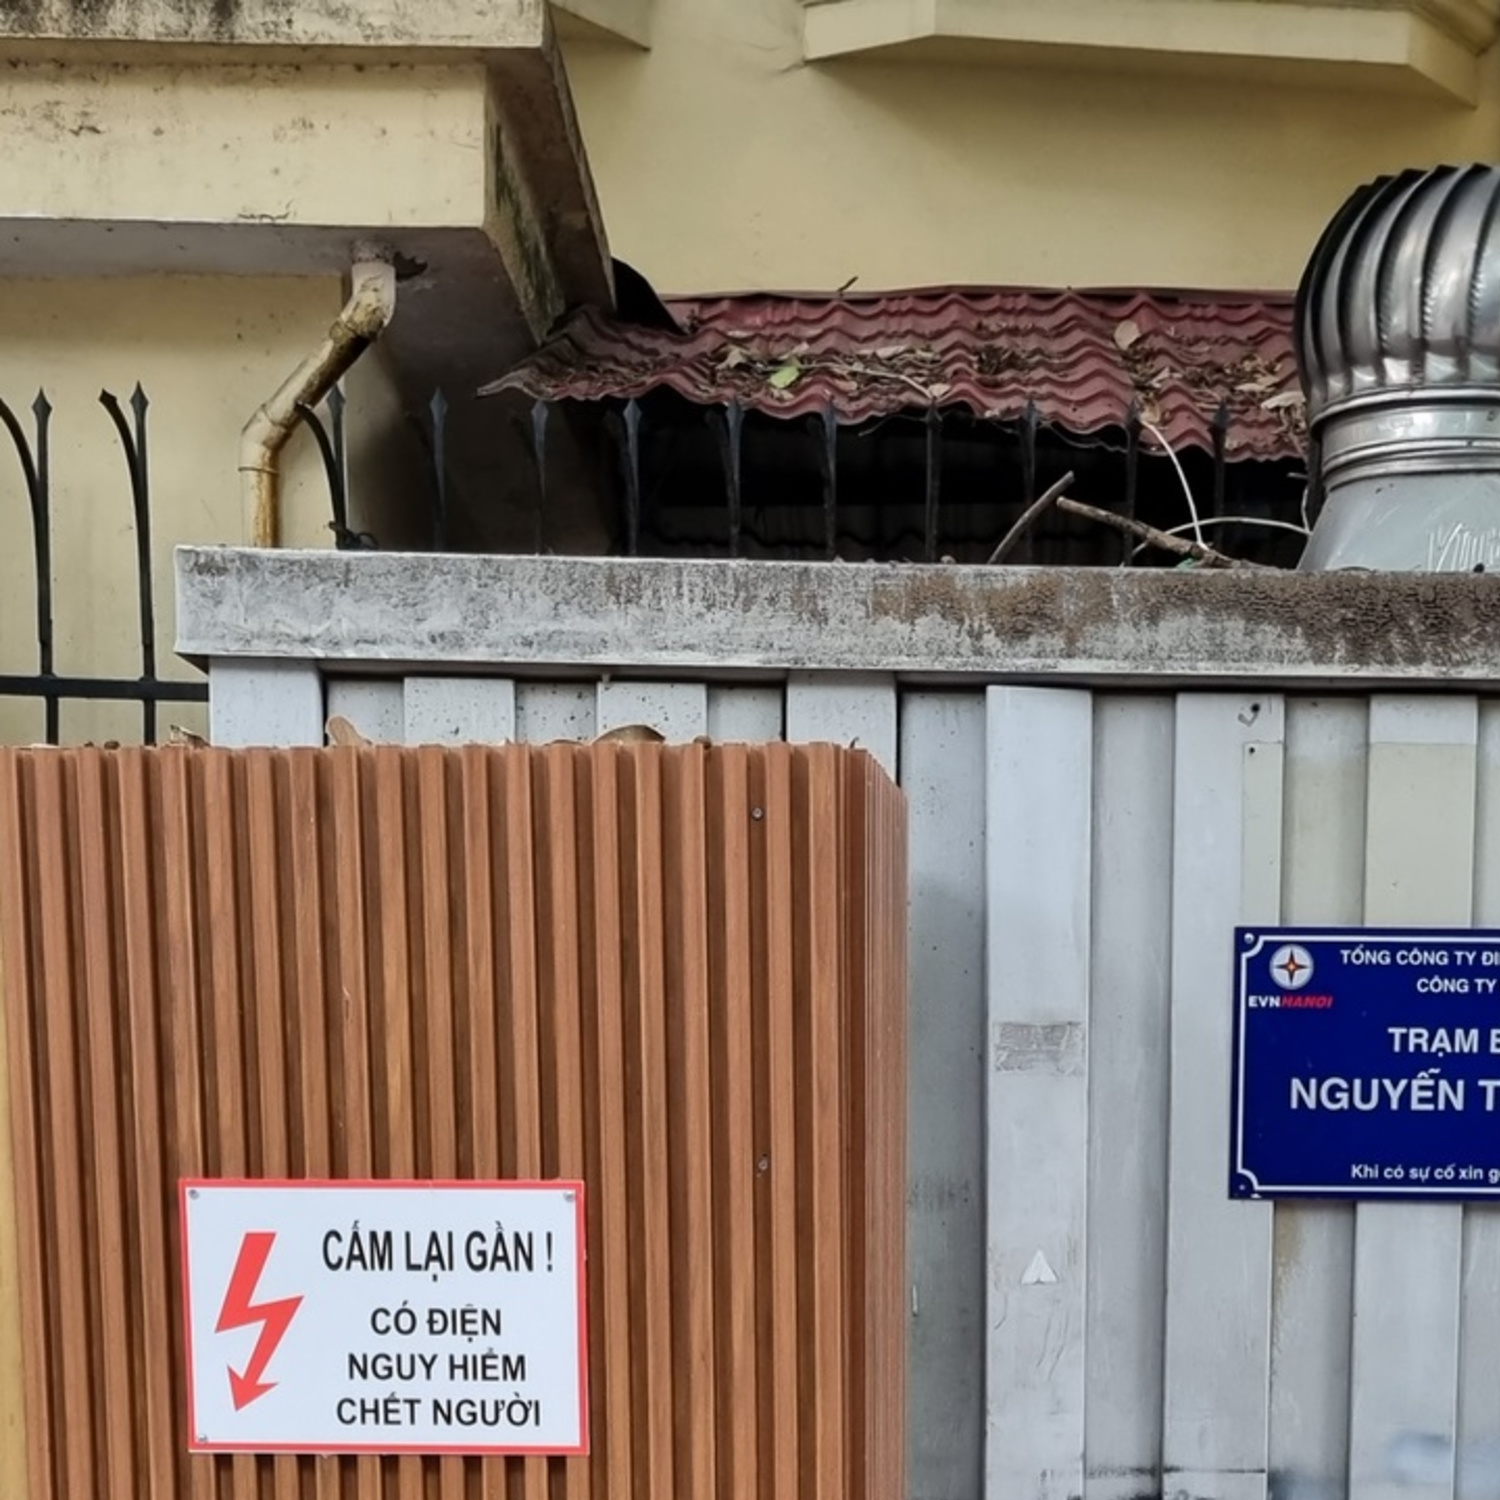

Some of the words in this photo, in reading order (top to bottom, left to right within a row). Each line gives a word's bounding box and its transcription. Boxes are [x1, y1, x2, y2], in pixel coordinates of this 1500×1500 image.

[1396, 945, 1449, 966] CÔNG
[1454, 951, 1477, 965] TY
[1416, 973, 1469, 993] CÔNG
[1474, 978, 1496, 993] TY
[1387, 1027, 1479, 1058] TRẠM
[1290, 1067, 1465, 1111] NGUYỄN
[1351, 1164, 1379, 1178] Khi
[1383, 1163, 1405, 1179] có
[1409, 1167, 1431, 1182] sự
[1434, 1163, 1455, 1180] cố
[1459, 1166, 1483, 1179] xin
[322, 1219, 394, 1271] CẤM
[405, 1230, 455, 1282] LẠI
[465, 1220, 534, 1272] GẦN
[370, 1300, 418, 1335] CÓ
[426, 1303, 502, 1343] ĐIỆN
[348, 1353, 439, 1381] NGUY
[448, 1346, 527, 1381] HIỂM
[336, 1391, 422, 1426] CHẾT
[432, 1392, 541, 1427] NGƯỜI
